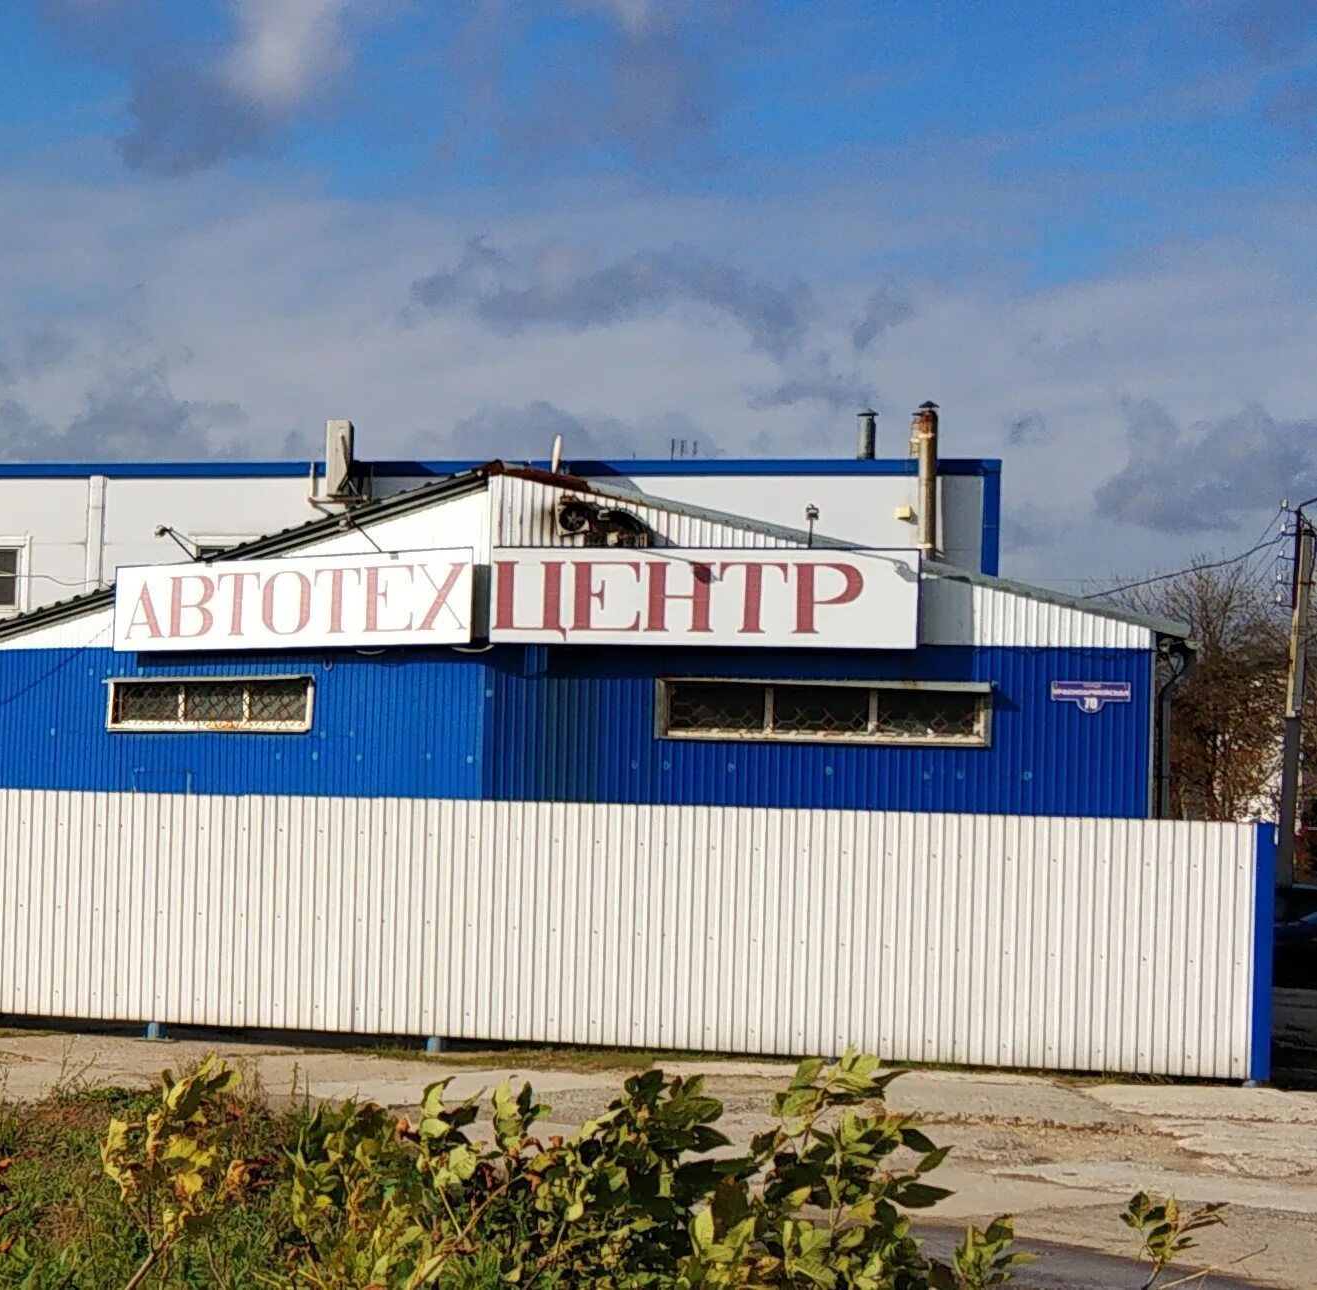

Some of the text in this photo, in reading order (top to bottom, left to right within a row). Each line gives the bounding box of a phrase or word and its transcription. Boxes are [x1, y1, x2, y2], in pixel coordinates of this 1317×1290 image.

[124, 560, 864, 641] АВТОТЕХ ЦЕНТР
[1083, 697, 1098, 710] 70
